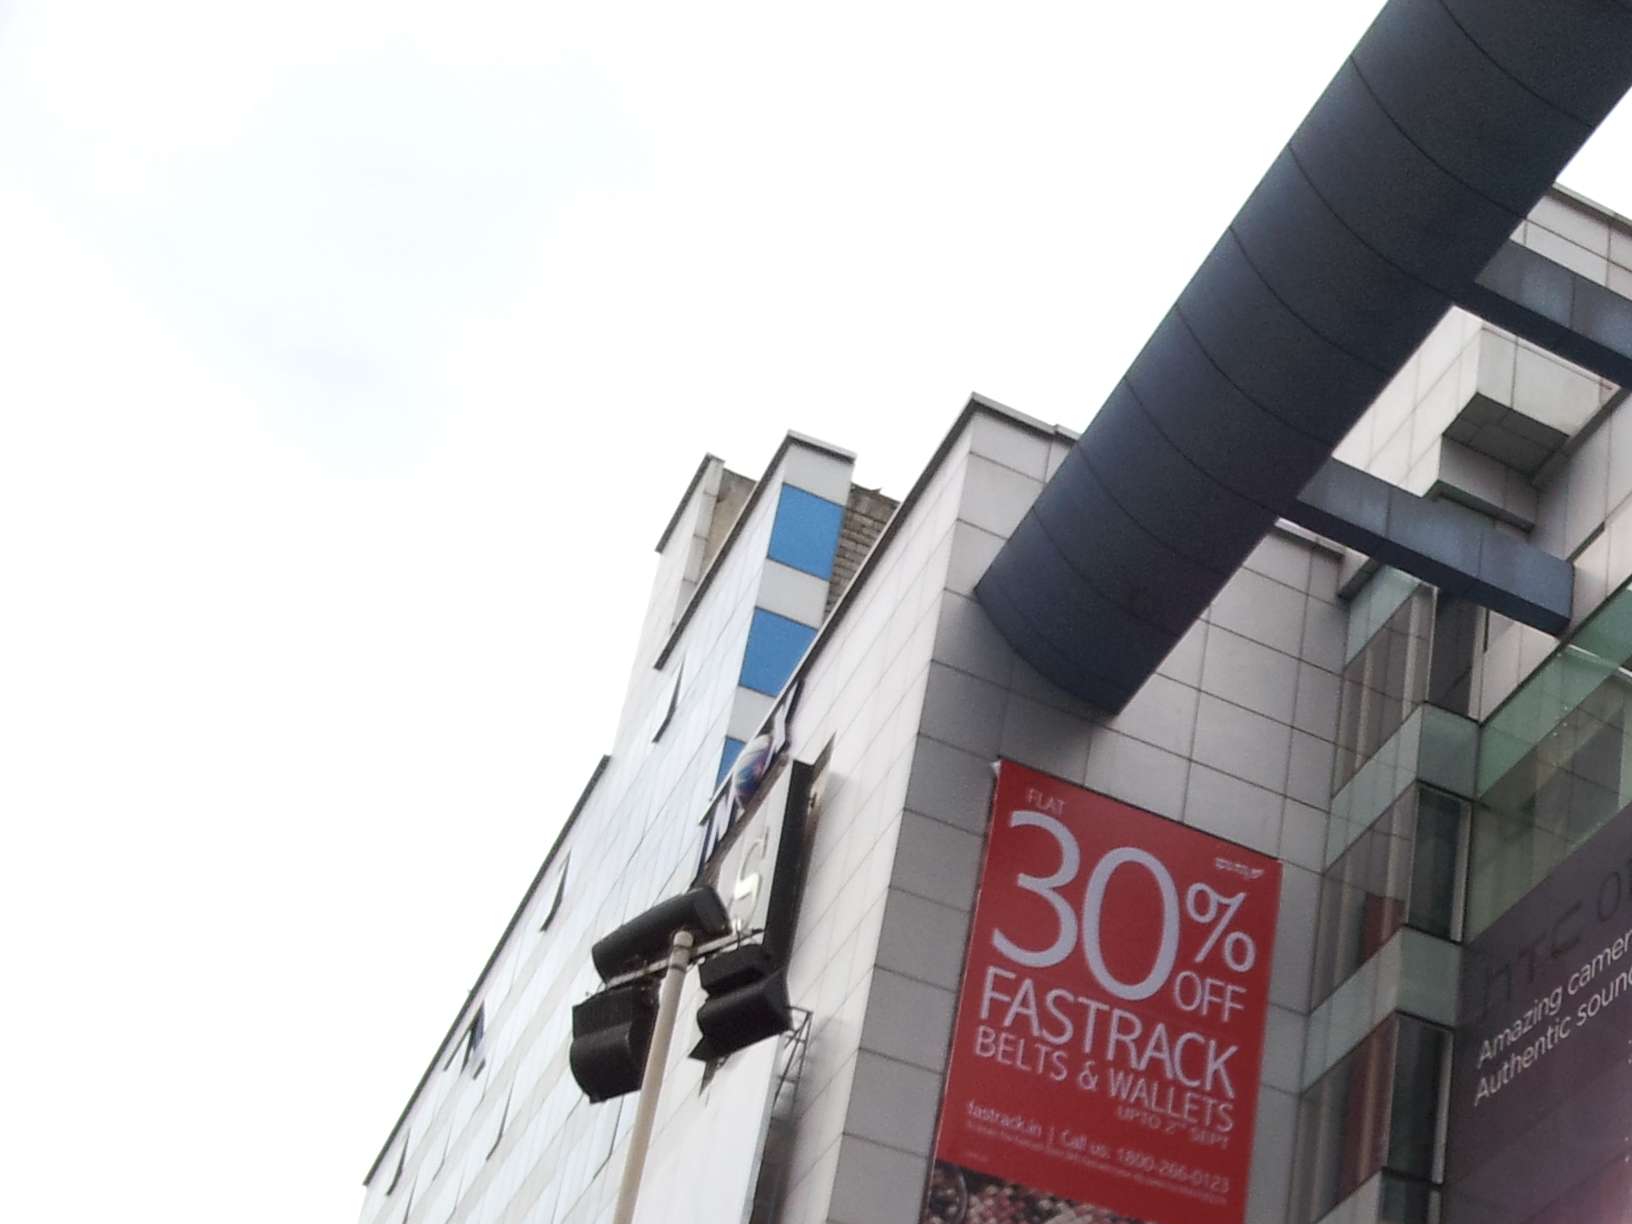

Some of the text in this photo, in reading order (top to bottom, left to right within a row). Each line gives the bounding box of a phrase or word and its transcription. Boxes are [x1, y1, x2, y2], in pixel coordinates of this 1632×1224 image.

[1025, 786, 1066, 817] FLAT
[991, 809, 1256, 1001] 30%
[979, 965, 1239, 1099] FASTRACK
[1173, 971, 1247, 1022] OFF
[1477, 984, 1563, 1070] Amazing
[974, 1024, 1234, 1132] BELTS & WALLETS
[1473, 1014, 1572, 1107] Authentic
[965, 1099, 1043, 1137] fastrack.in
